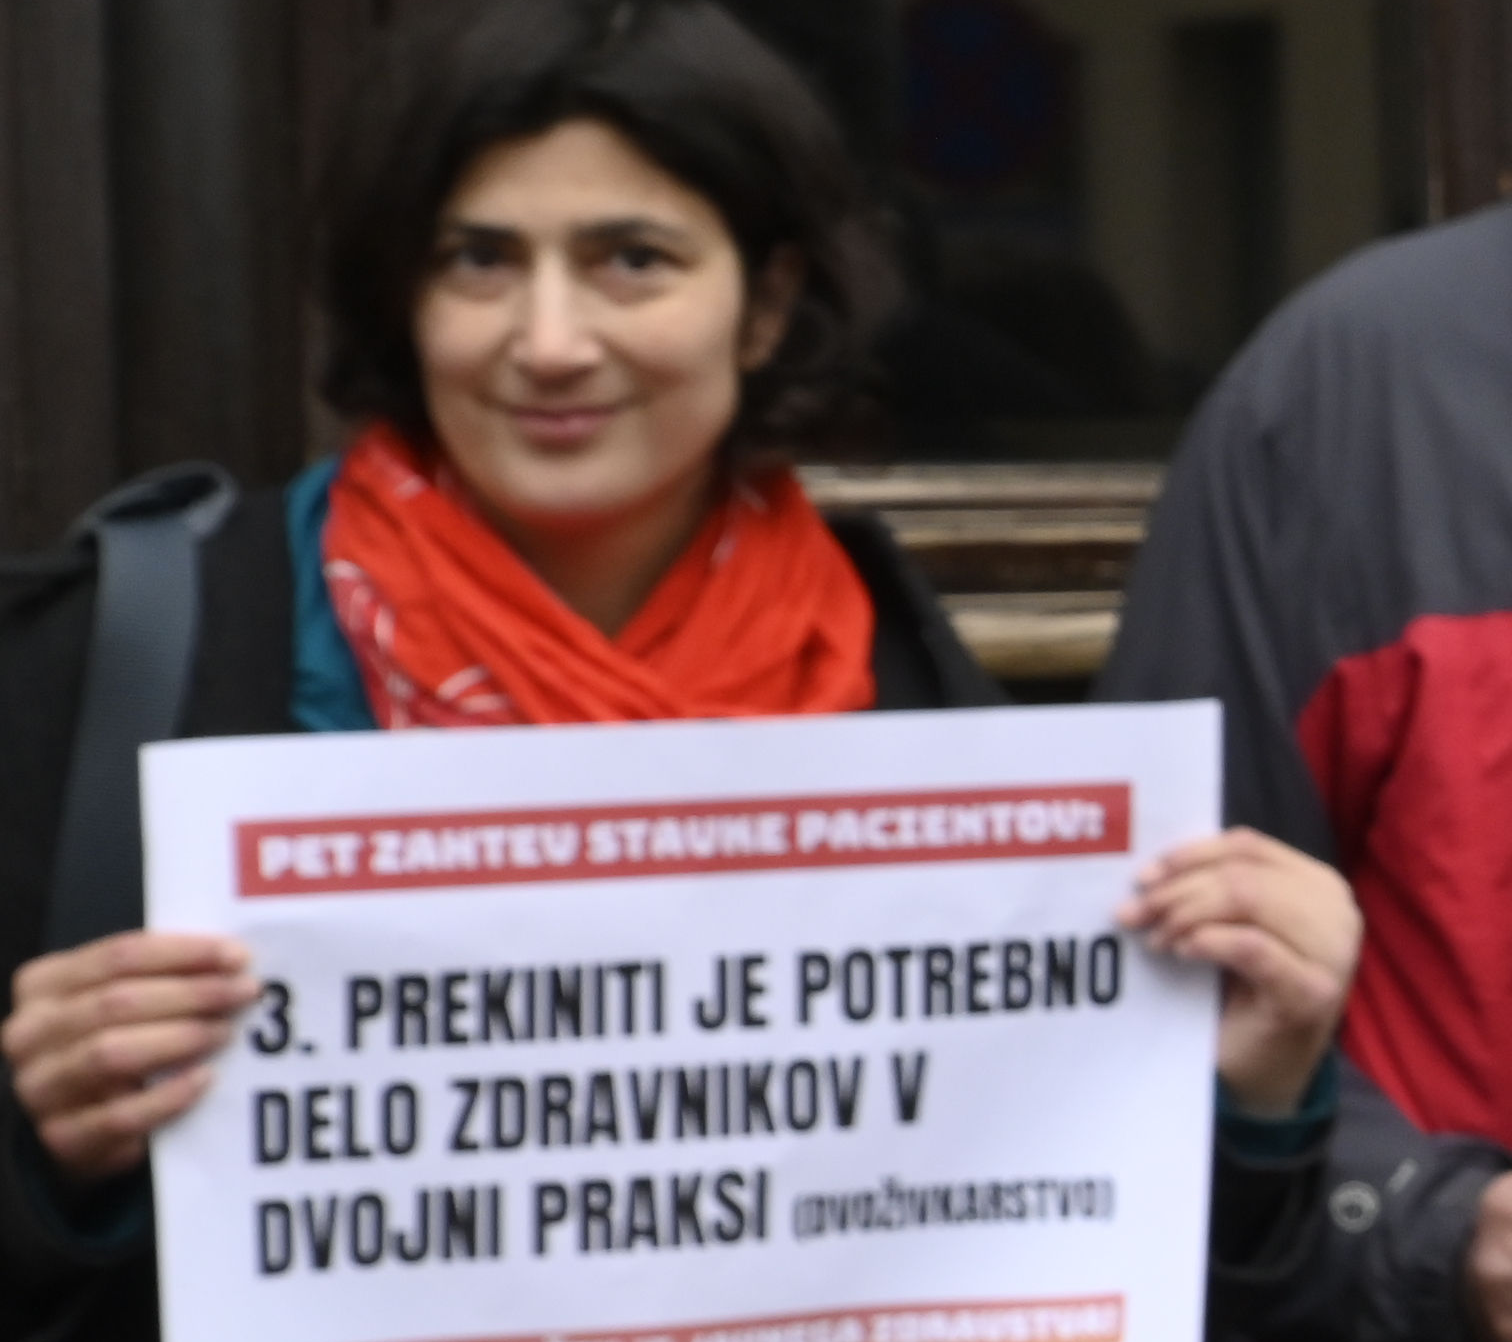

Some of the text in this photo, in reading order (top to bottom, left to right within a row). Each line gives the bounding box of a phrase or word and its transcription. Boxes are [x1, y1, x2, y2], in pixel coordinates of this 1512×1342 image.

[259, 830, 362, 880] PET
[369, 822, 580, 875] ZAHTEV
[586, 811, 790, 864] STAVKE
[252, 935, 1121, 1056] 3. PREKINITI JE POTREBNO
[255, 1053, 929, 1164] DELO ZDRAVNIKOV V
[258, 1184, 501, 1276] DVOJNI
[533, 1169, 769, 1255] PRAKSI
